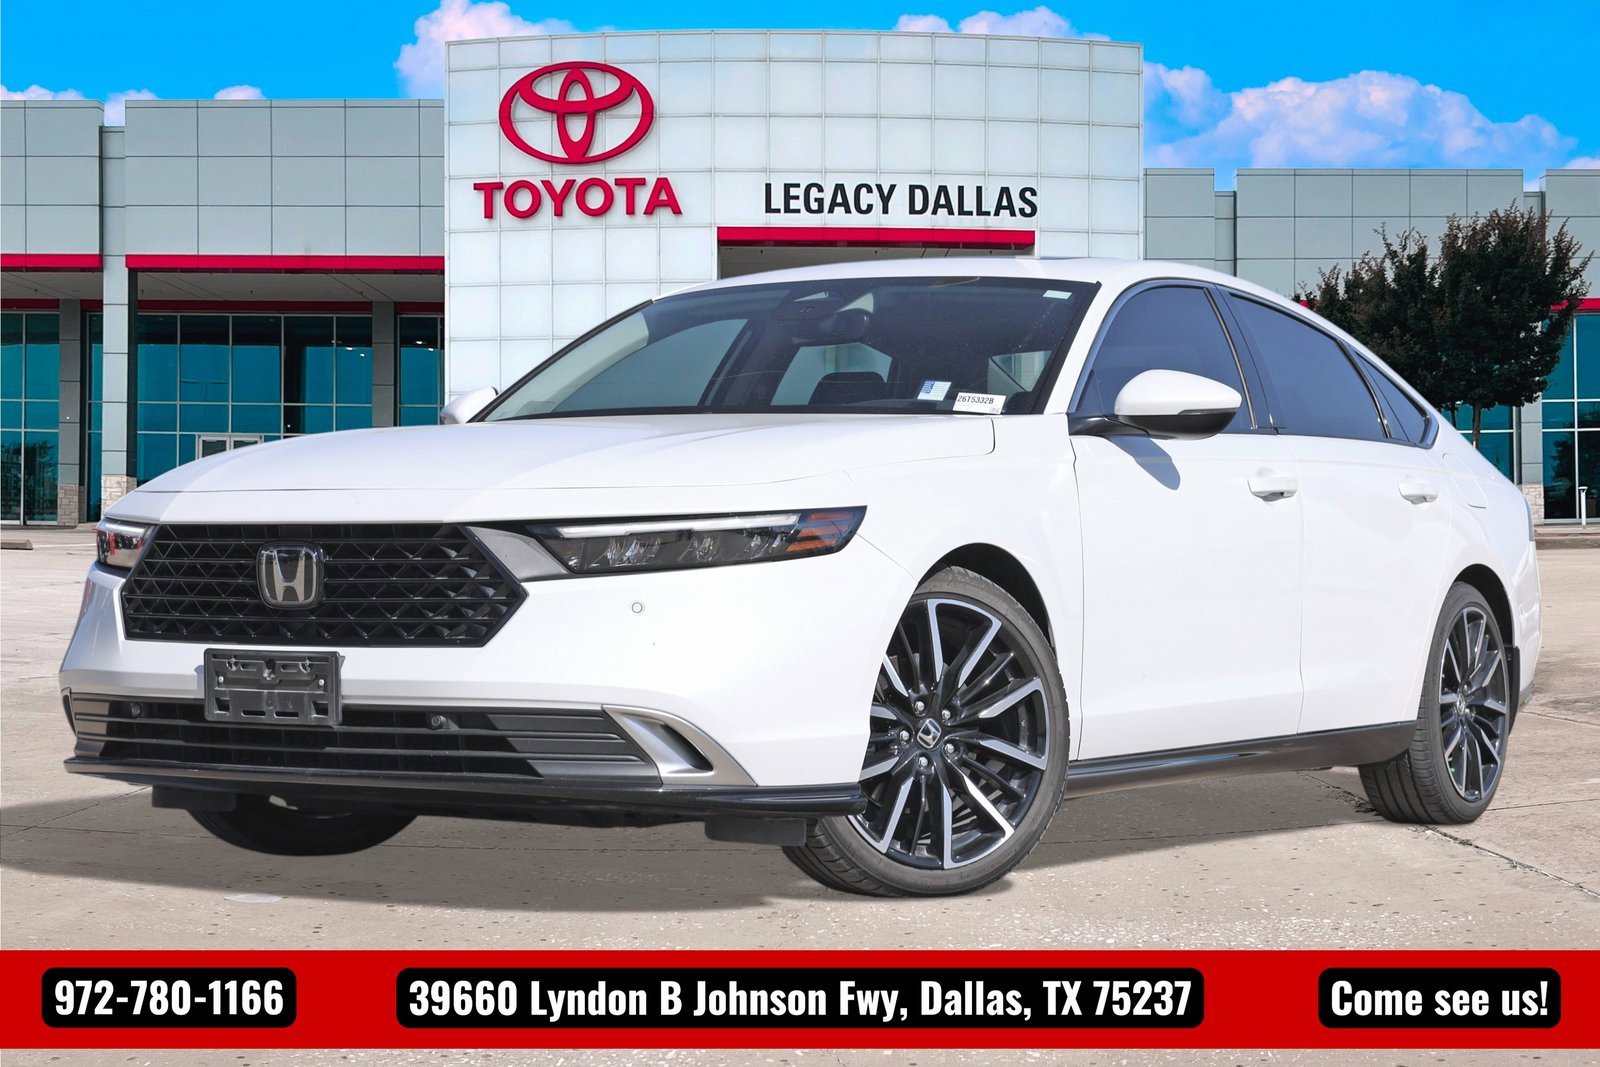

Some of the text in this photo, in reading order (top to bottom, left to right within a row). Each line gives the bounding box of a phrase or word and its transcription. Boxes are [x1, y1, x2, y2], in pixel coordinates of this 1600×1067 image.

[474, 177, 682, 219] TOYOTA
[764, 182, 1038, 218] LEGACY DALLAS
